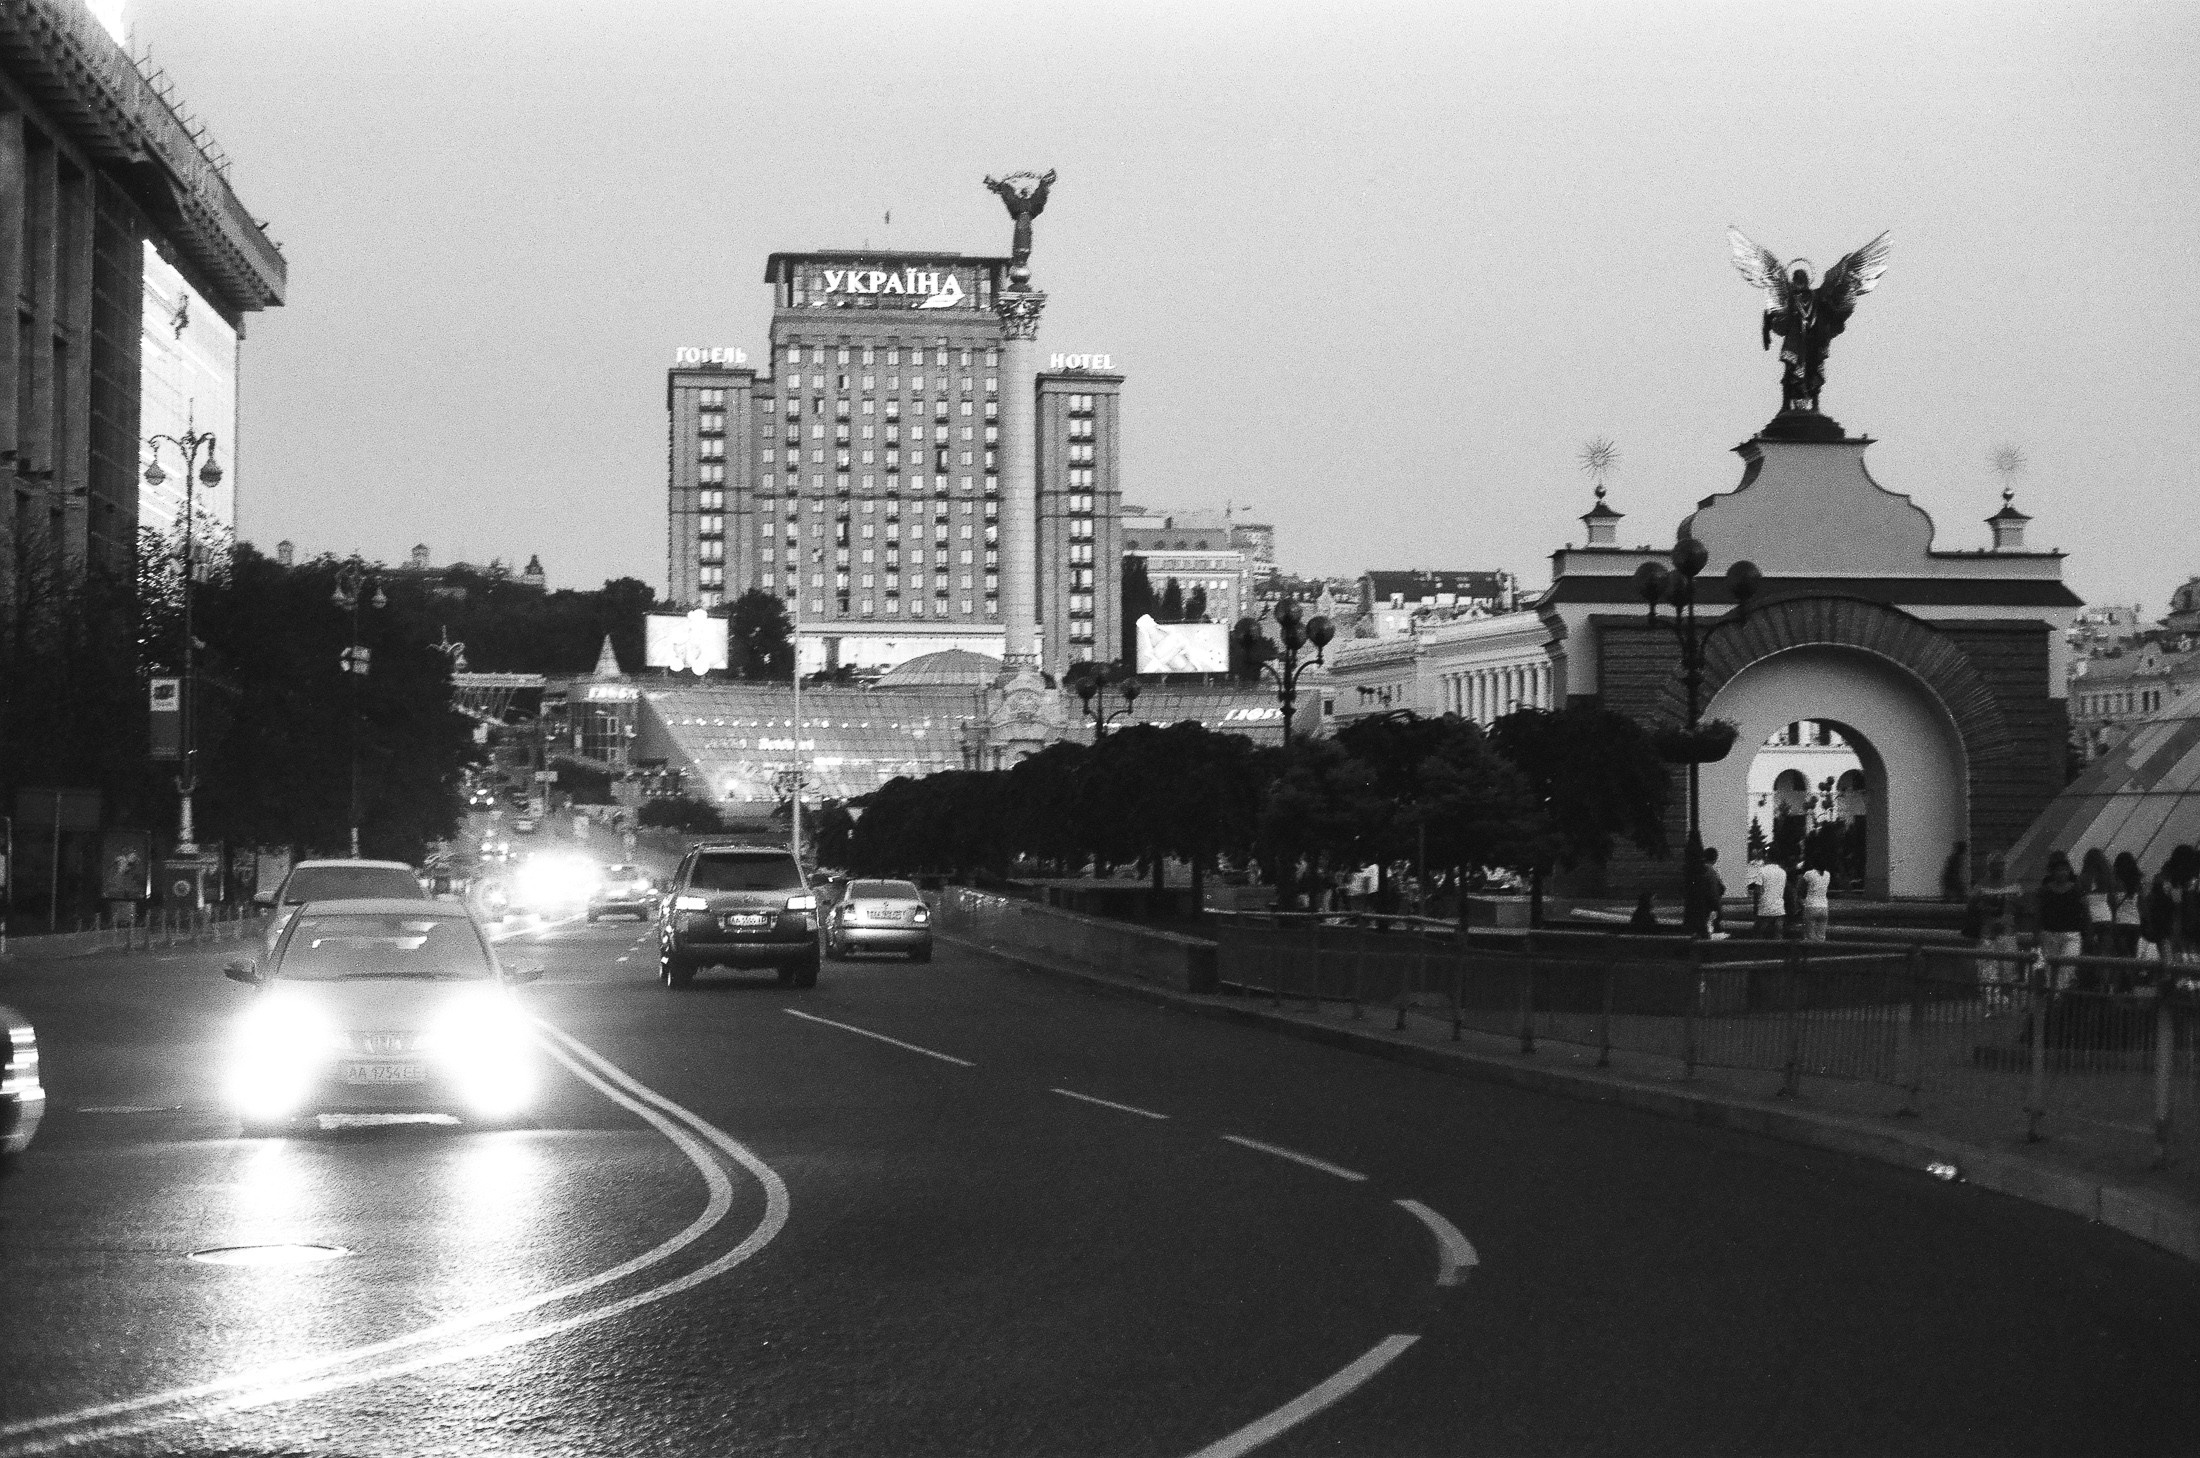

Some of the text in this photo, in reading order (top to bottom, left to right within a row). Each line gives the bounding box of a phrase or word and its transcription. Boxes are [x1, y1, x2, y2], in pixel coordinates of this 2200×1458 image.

[823, 268, 963, 297] УКРАЇНА
[676, 346, 748, 363] ГОТЕЛЬ
[1050, 353, 1116, 370] HOTEL
